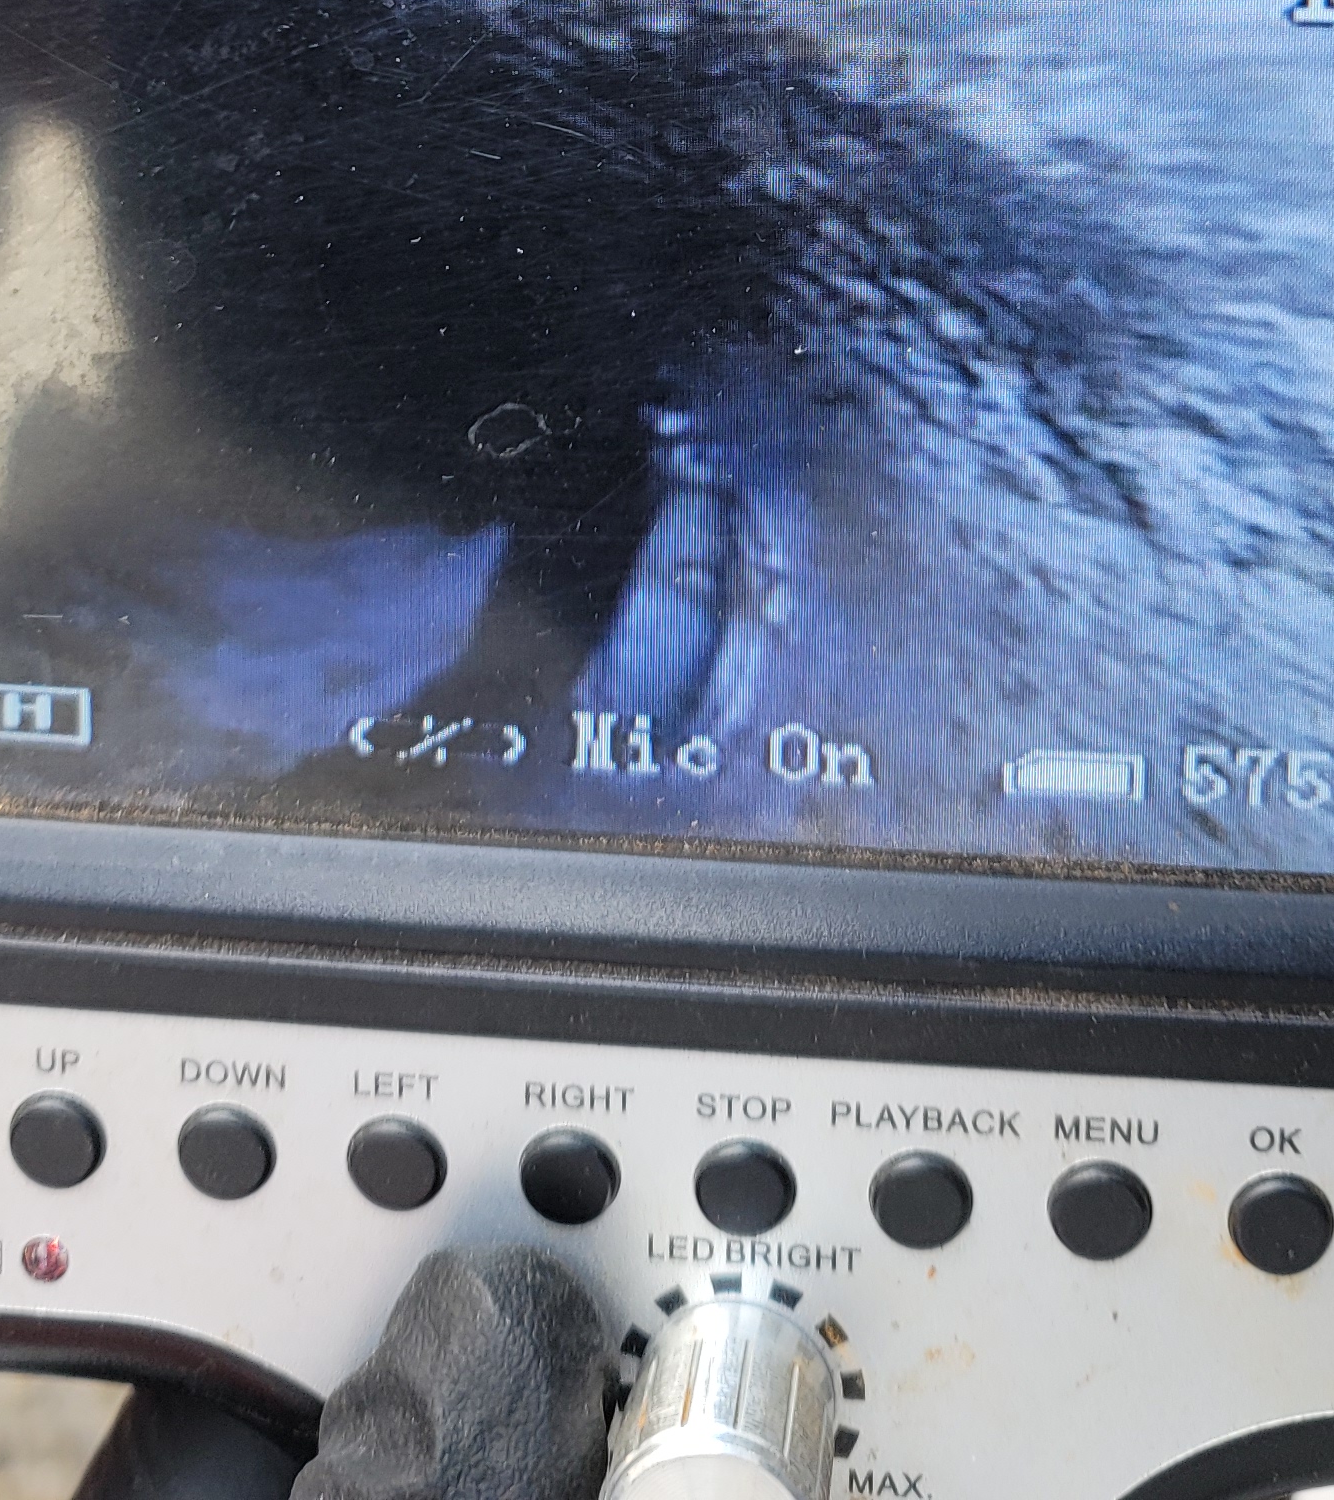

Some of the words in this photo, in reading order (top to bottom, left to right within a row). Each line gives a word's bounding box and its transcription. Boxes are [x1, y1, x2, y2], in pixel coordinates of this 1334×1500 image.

[769, 721, 876, 787] On
[35, 1046, 82, 1075] UP
[179, 1057, 287, 1092] DOWN
[352, 1069, 440, 1101] LEFT
[523, 1080, 636, 1115] RIGHT
[695, 1092, 793, 1125] STOP
[830, 1100, 1022, 1139] PLAYBACK
[1053, 1114, 1161, 1146] MENU
[1248, 1125, 1303, 1156] OK
[647, 1232, 715, 1263] LED
[725, 1238, 862, 1274] BRIGHT
[847, 1467, 934, 1500] MAX.
